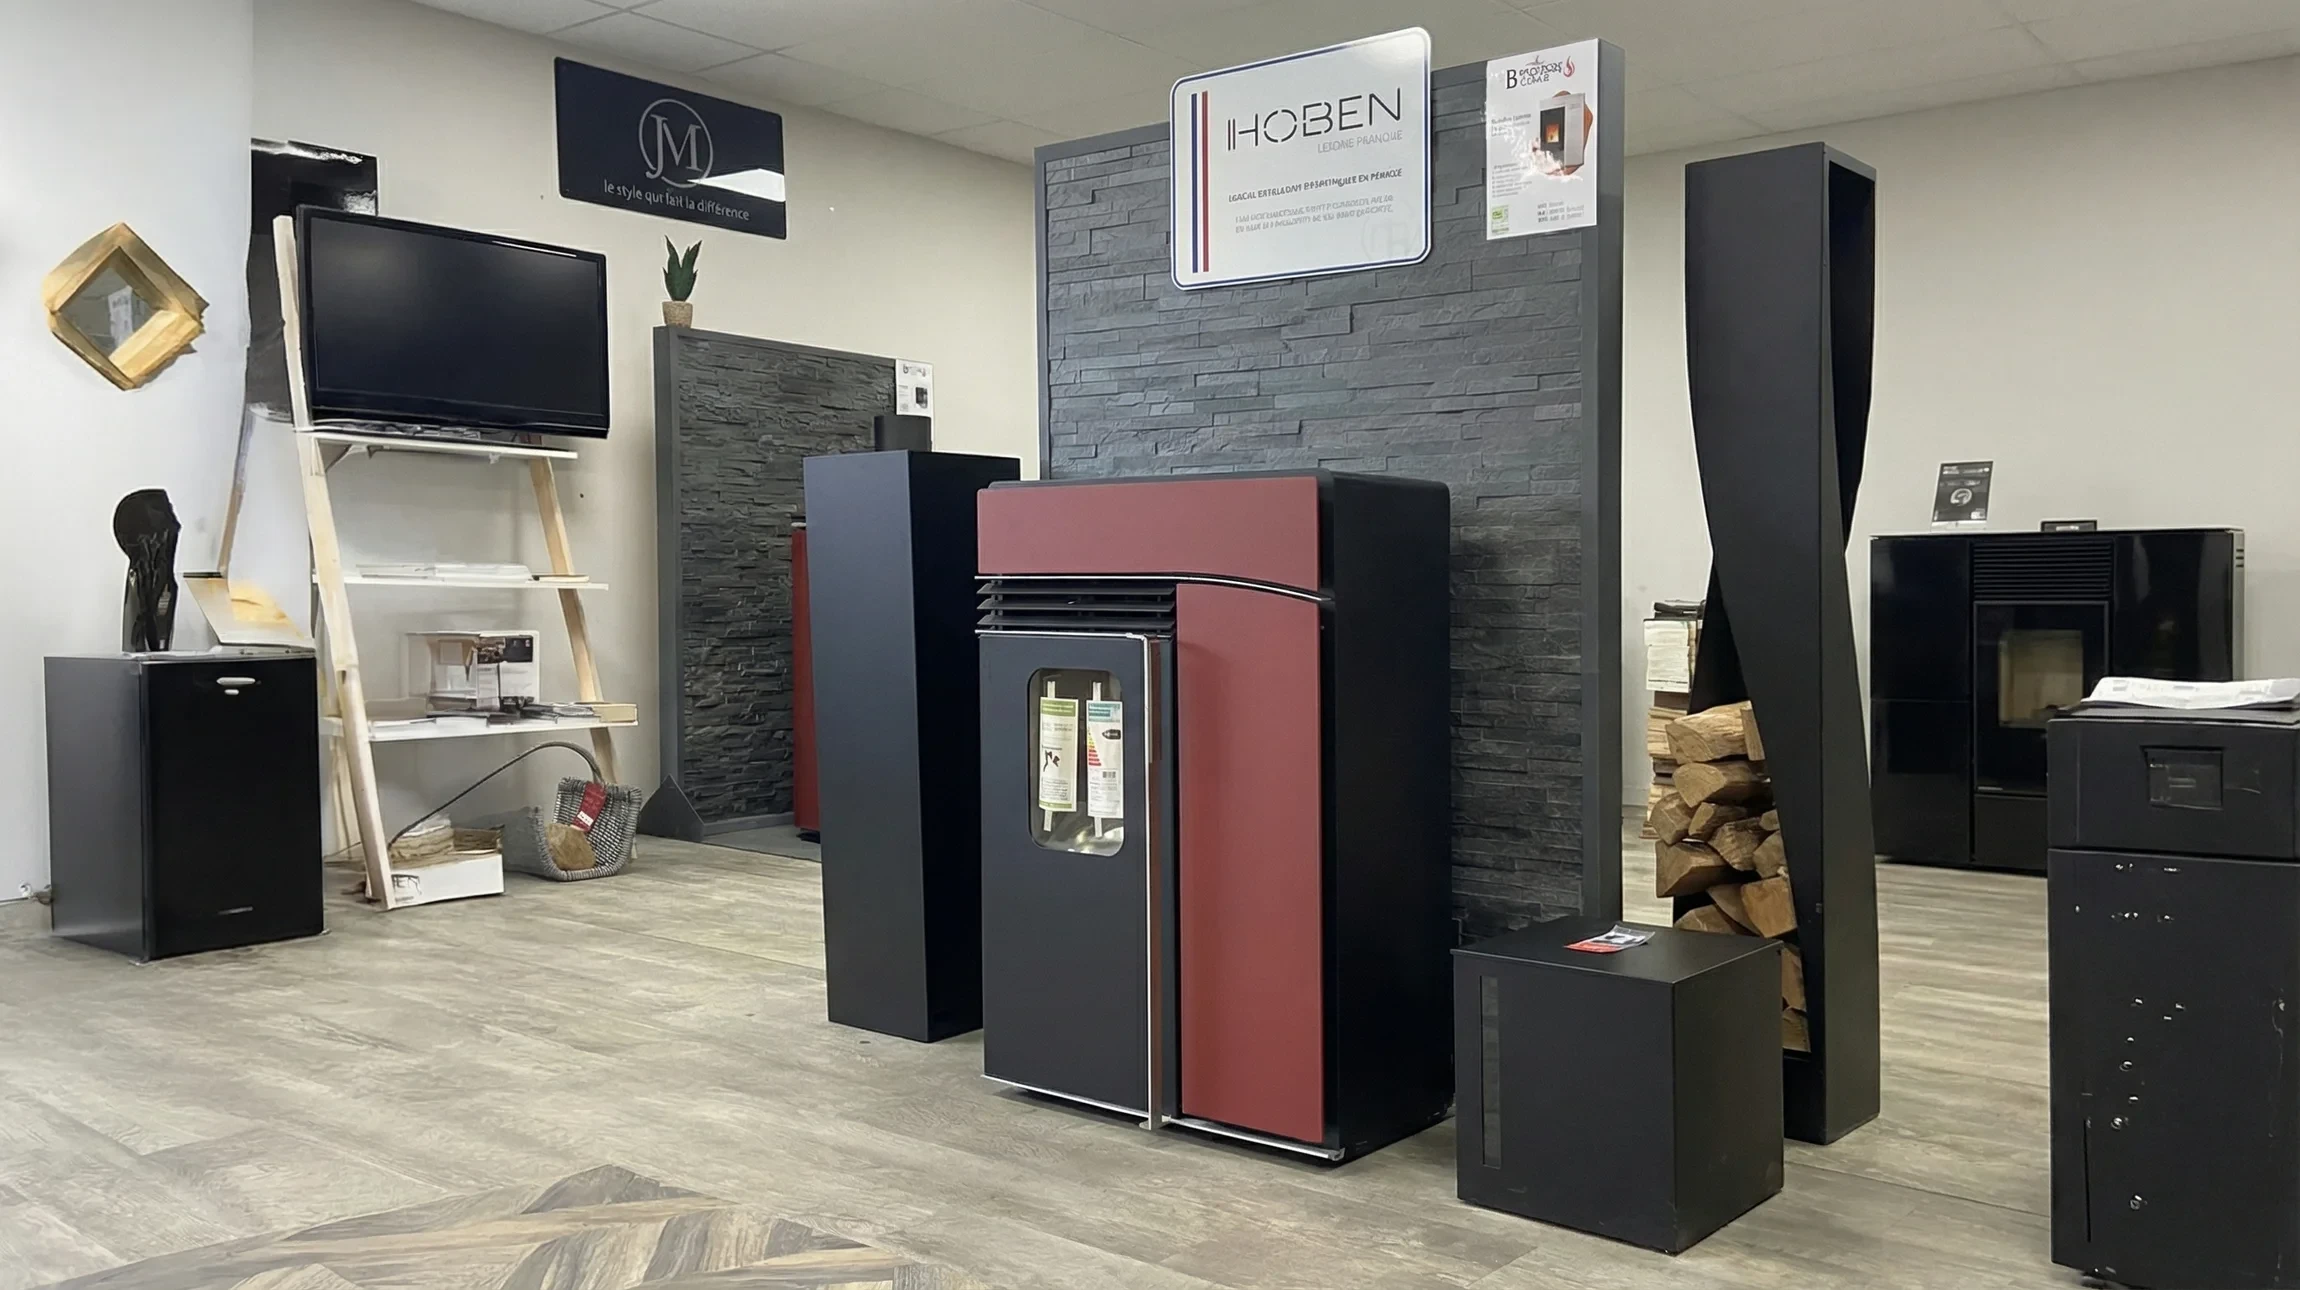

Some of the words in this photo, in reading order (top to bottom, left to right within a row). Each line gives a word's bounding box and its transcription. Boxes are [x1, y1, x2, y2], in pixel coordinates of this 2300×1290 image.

[604, 179, 615, 193] le
[617, 185, 643, 201] style
[686, 196, 695, 210] la
